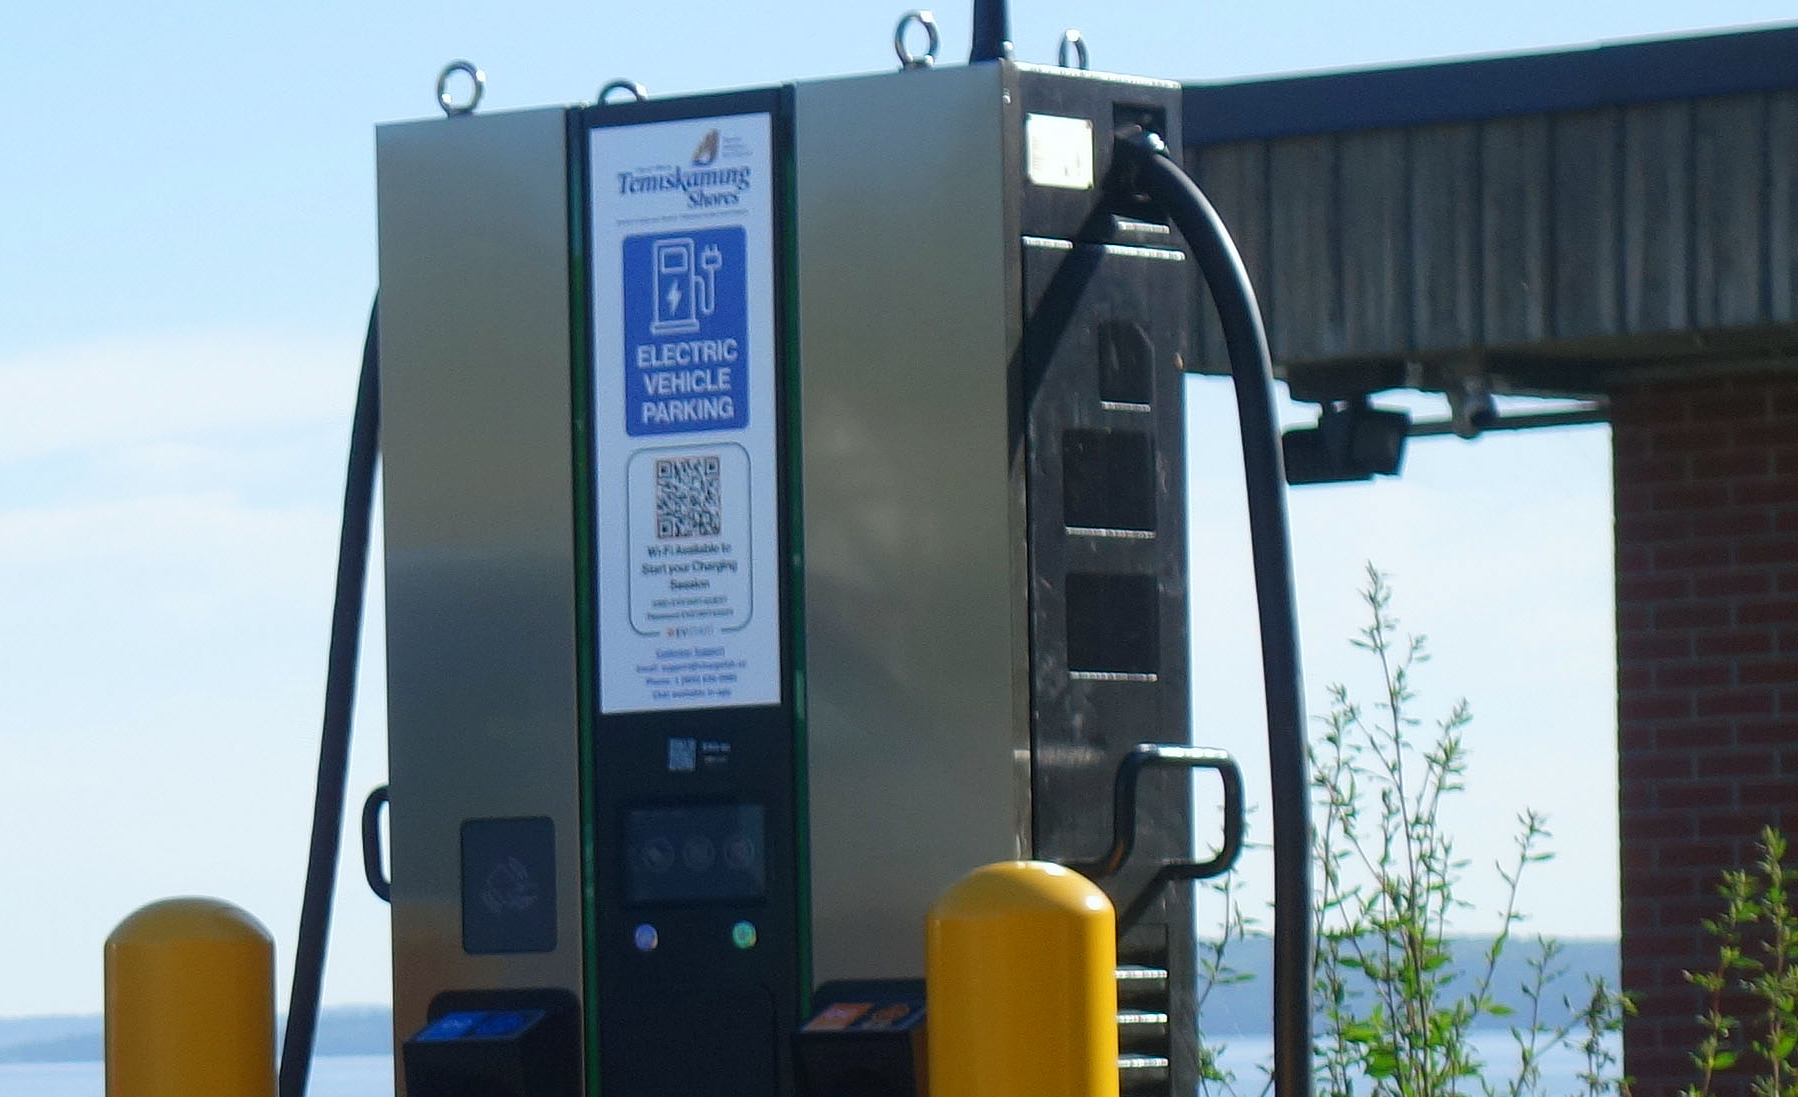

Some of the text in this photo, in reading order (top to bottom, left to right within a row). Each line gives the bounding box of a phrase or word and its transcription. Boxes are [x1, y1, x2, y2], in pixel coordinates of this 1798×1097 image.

[617, 166, 751, 196] Temiskaming
[687, 190, 740, 208] Shores
[636, 337, 739, 369] ELECTRIC
[643, 367, 731, 396] VEHICLE
[642, 396, 734, 424] PARKING
[691, 560, 738, 574] Charging
